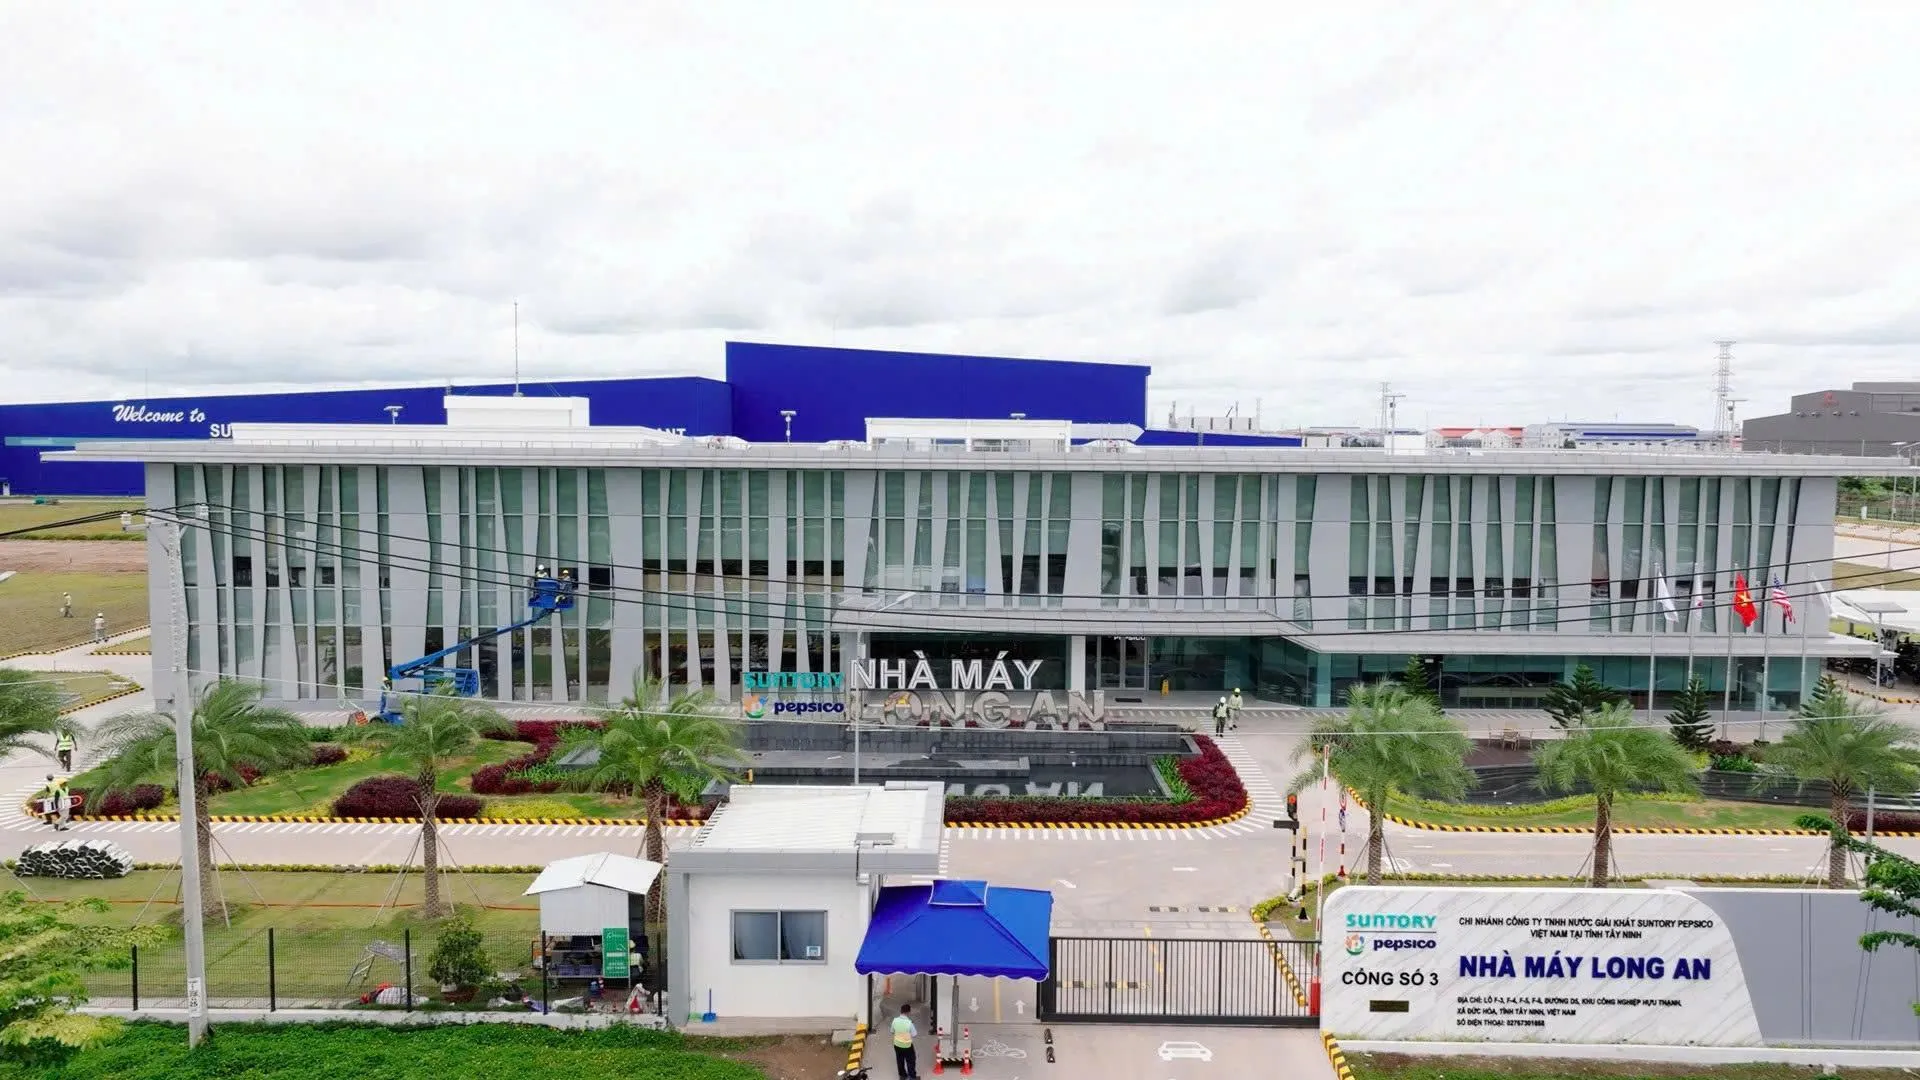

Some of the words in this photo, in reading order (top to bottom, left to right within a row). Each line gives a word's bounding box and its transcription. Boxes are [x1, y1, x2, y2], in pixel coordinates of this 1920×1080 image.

[112, 404, 185, 422] Welcome
[189, 408, 206, 422] to
[850, 650, 938, 690] NHÀ
[951, 650, 1044, 690] MÁY
[774, 702, 845, 715] pepsico
[1024, 689, 1105, 731] AN
[1458, 917, 1473, 926] CHI
[1475, 916, 1504, 926] NHÁNH
[1506, 916, 1530, 926] CÔNG
[1532, 918, 1542, 926] TY
[1544, 918, 1566, 926] TNHH
[1613, 917, 1636, 928] KHÁT
[1637, 919, 1676, 928] SUNTORY
[1677, 919, 1713, 928] PEPSICO
[1549, 929, 1568, 938] NAM
[1570, 930, 1583, 940] TẠI
[1622, 931, 1642, 939] NINH
[1373, 939, 1437, 951] pepsico
[1459, 949, 1516, 978] NHÀ
[1525, 950, 1583, 978] MÁY
[1591, 956, 1665, 979] LONG
[1672, 958, 1711, 980] AN
[1429, 973, 1439, 986] 3
